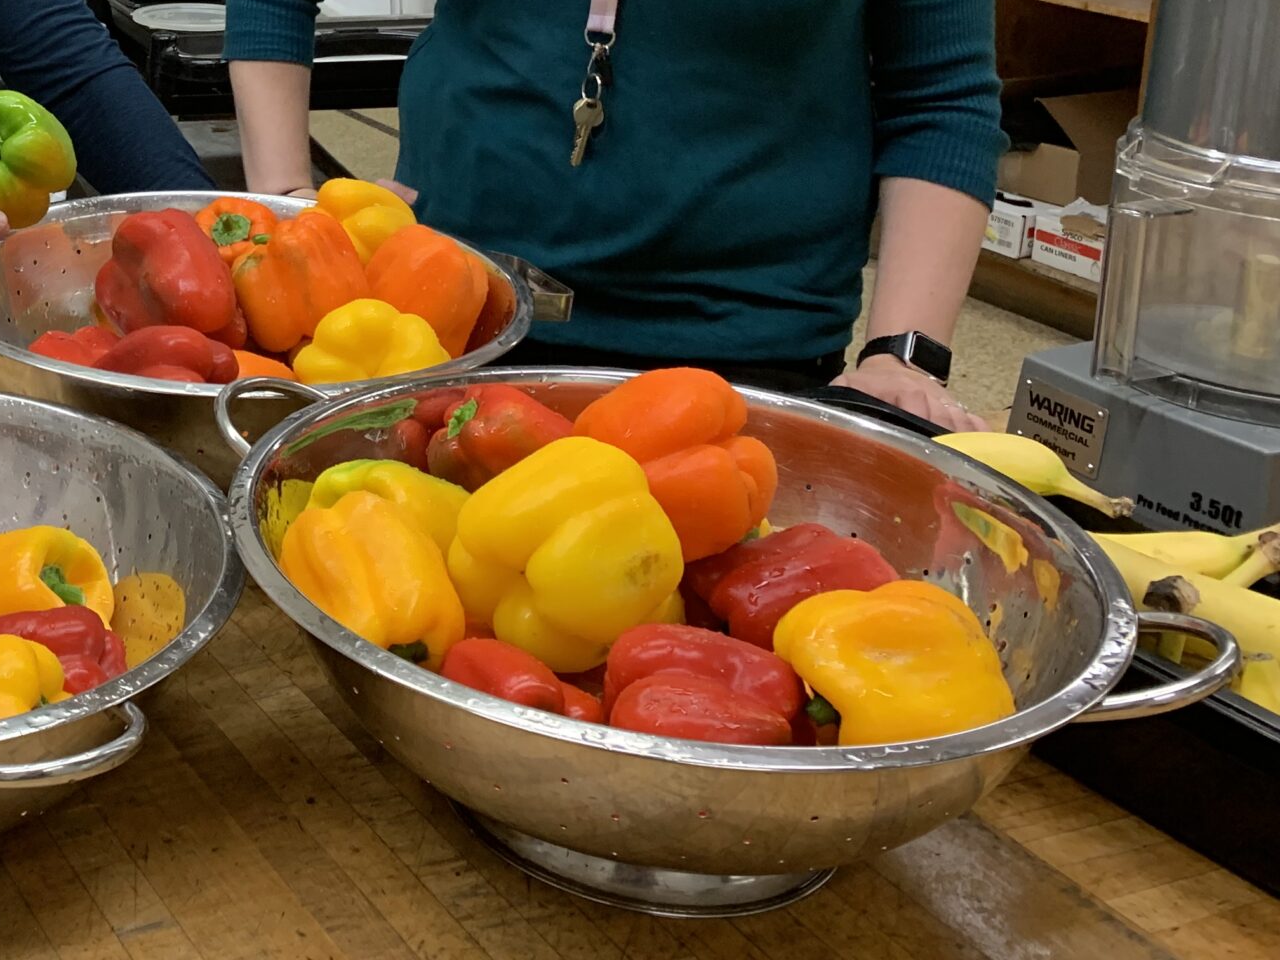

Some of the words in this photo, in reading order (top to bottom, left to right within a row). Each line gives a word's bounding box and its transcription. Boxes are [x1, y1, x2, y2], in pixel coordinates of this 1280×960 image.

[1040, 244, 1054, 254] CAN
[1054, 248, 1077, 262] LINERS
[1026, 412, 1090, 448] COMMERCIAL
[1029, 389, 1096, 435] WARING
[1136, 493, 1154, 511] Pro
[1155, 502, 1180, 522] Food
[1189, 491, 1243, 529] 3.5Qt
